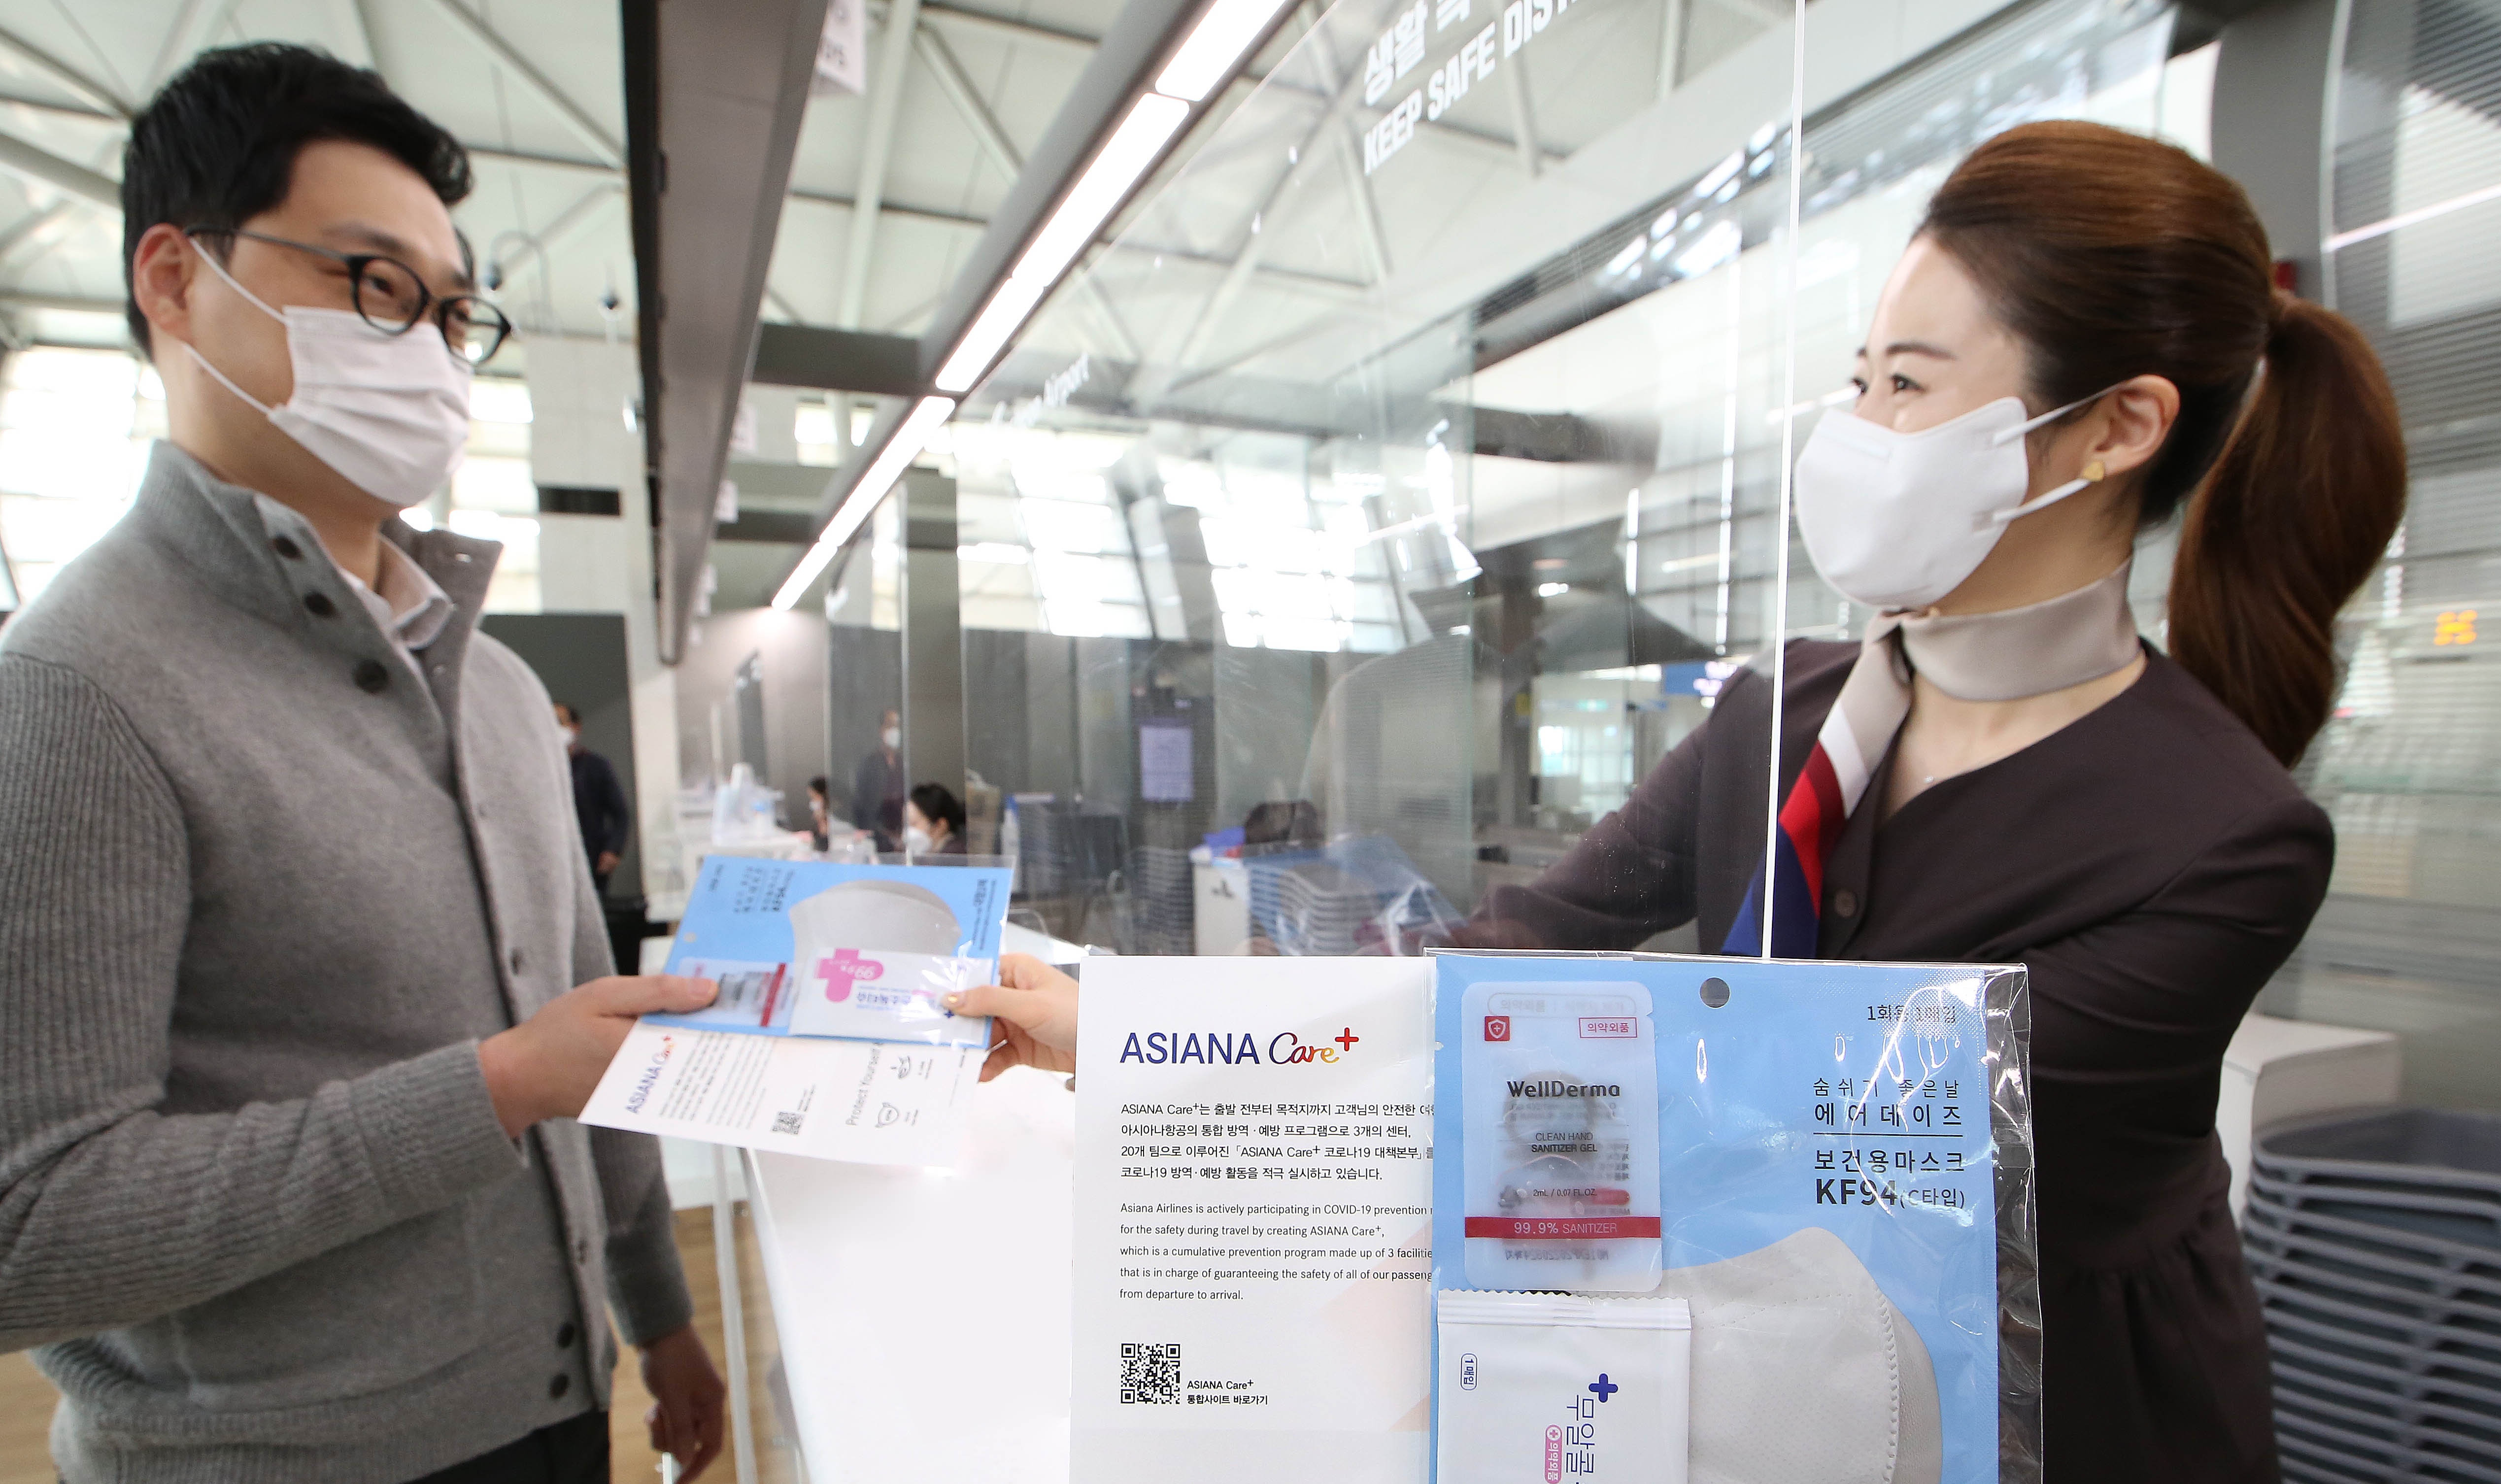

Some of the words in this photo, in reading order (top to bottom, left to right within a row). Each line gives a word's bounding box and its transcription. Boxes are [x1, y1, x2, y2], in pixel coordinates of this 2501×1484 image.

[1364, 0, 1428, 106] 생활
[1364, 89, 1422, 175] KEEP
[1428, 21, 1496, 121] SAFE
[1588, 1022, 1629, 1033] 의약외품
[1120, 1032, 1260, 1065] ASIANA
[626, 1066, 662, 1114] ASIANA
[1507, 1080, 1620, 1097] WellDerma
[1121, 1104, 1163, 1114] ASIANA
[1214, 1104, 1236, 1115] 출발
[1240, 1103, 1272, 1115] 전부터
[1276, 1104, 1330, 1115] 목적지까지
[1335, 1104, 1378, 1115] 고객님의
[1383, 1104, 1416, 1116] 안전한
[1815, 1103, 1961, 1127] 에어데이즈
[1121, 1123, 1197, 1136] 아시아나항공의
[1201, 1124, 1223, 1137] 통합
[1284, 1125, 1350, 1137] 프로그램으로
[1353, 1125, 1382, 1137] 3개의
[1386, 1125, 1411, 1138] 센터,
[1536, 1133, 1565, 1141] CLEAN
[1568, 1133, 1593, 1141] HAND
[1121, 1146, 1145, 1157] 20개
[1149, 1146, 1182, 1157] 팀으로
[1186, 1146, 1229, 1158] 이루어진
[1287, 1145, 1320, 1157] Care+
[1324, 1147, 1370, 1158] 코로나19
[1814, 1149, 1964, 1174] 보건용마스크
[1121, 1167, 1167, 1179] 코로나19
[1225, 1167, 1258, 1180] 활동을
[1262, 1167, 1284, 1180] 적극
[1288, 1168, 1332, 1180] 실시하고
[1336, 1168, 1382, 1180] 있습니다.
[1120, 1203, 1153, 1213] Asiana
[1156, 1203, 1192, 1213] Airlines
[1196, 1204, 1203, 1213] is
[1207, 1204, 1244, 1216] actively
[1248, 1204, 1309, 1216] participating
[1313, 1205, 1320, 1214] in
[1324, 1205, 1371, 1214] COVID-19
[1374, 1205, 1427, 1217] prevention
[1120, 1224, 1134, 1234] for
[1136, 1225, 1151, 1234] the
[1155, 1224, 1185, 1237] safety
[1188, 1225, 1218, 1237] during
[1222, 1225, 1249, 1235] travel
[1252, 1226, 1264, 1238] by
[1267, 1226, 1307, 1238] creating
[1310, 1226, 1349, 1236] ASIANA
[1514, 1222, 1558, 1234] 99.9%
[1562, 1223, 1617, 1233] SANITIZER
[1120, 1246, 1149, 1255] which
[1152, 1246, 1159, 1255] is
[1172, 1247, 1225, 1256] cumulative
[1229, 1247, 1281, 1259] prevention
[1284, 1249, 1325, 1259] program
[1329, 1248, 1356, 1257] made
[1360, 1250, 1372, 1260] up
[1375, 1248, 1385, 1258] of
[1388, 1248, 1394, 1257] 3
[1120, 1267, 1140, 1277] that
[1143, 1268, 1150, 1277] is
[1153, 1268, 1162, 1277] in
[1166, 1268, 1198, 1280] charge
[1202, 1268, 1212, 1278] of
[1214, 1269, 1279, 1281] guaranteeing
[1282, 1269, 1297, 1279] the
[1301, 1269, 1330, 1281] safety
[1334, 1269, 1343, 1279] of
[1346, 1269, 1356, 1279] all
[1360, 1270, 1370, 1280] of
[1120, 1289, 1142, 1299] from
[1146, 1289, 1194, 1301] departure
[1197, 1290, 1207, 1299] to
[1210, 1289, 1243, 1300] arrival.
[1187, 1381, 1223, 1390] ASIANA
[1187, 1394, 1230, 1405] 통합사이트
[1234, 1395, 1268, 1405] 바로가기
[1566, 1395, 1595, 1476] 무알콜
[1548, 1442, 1558, 1481] 의약외품
